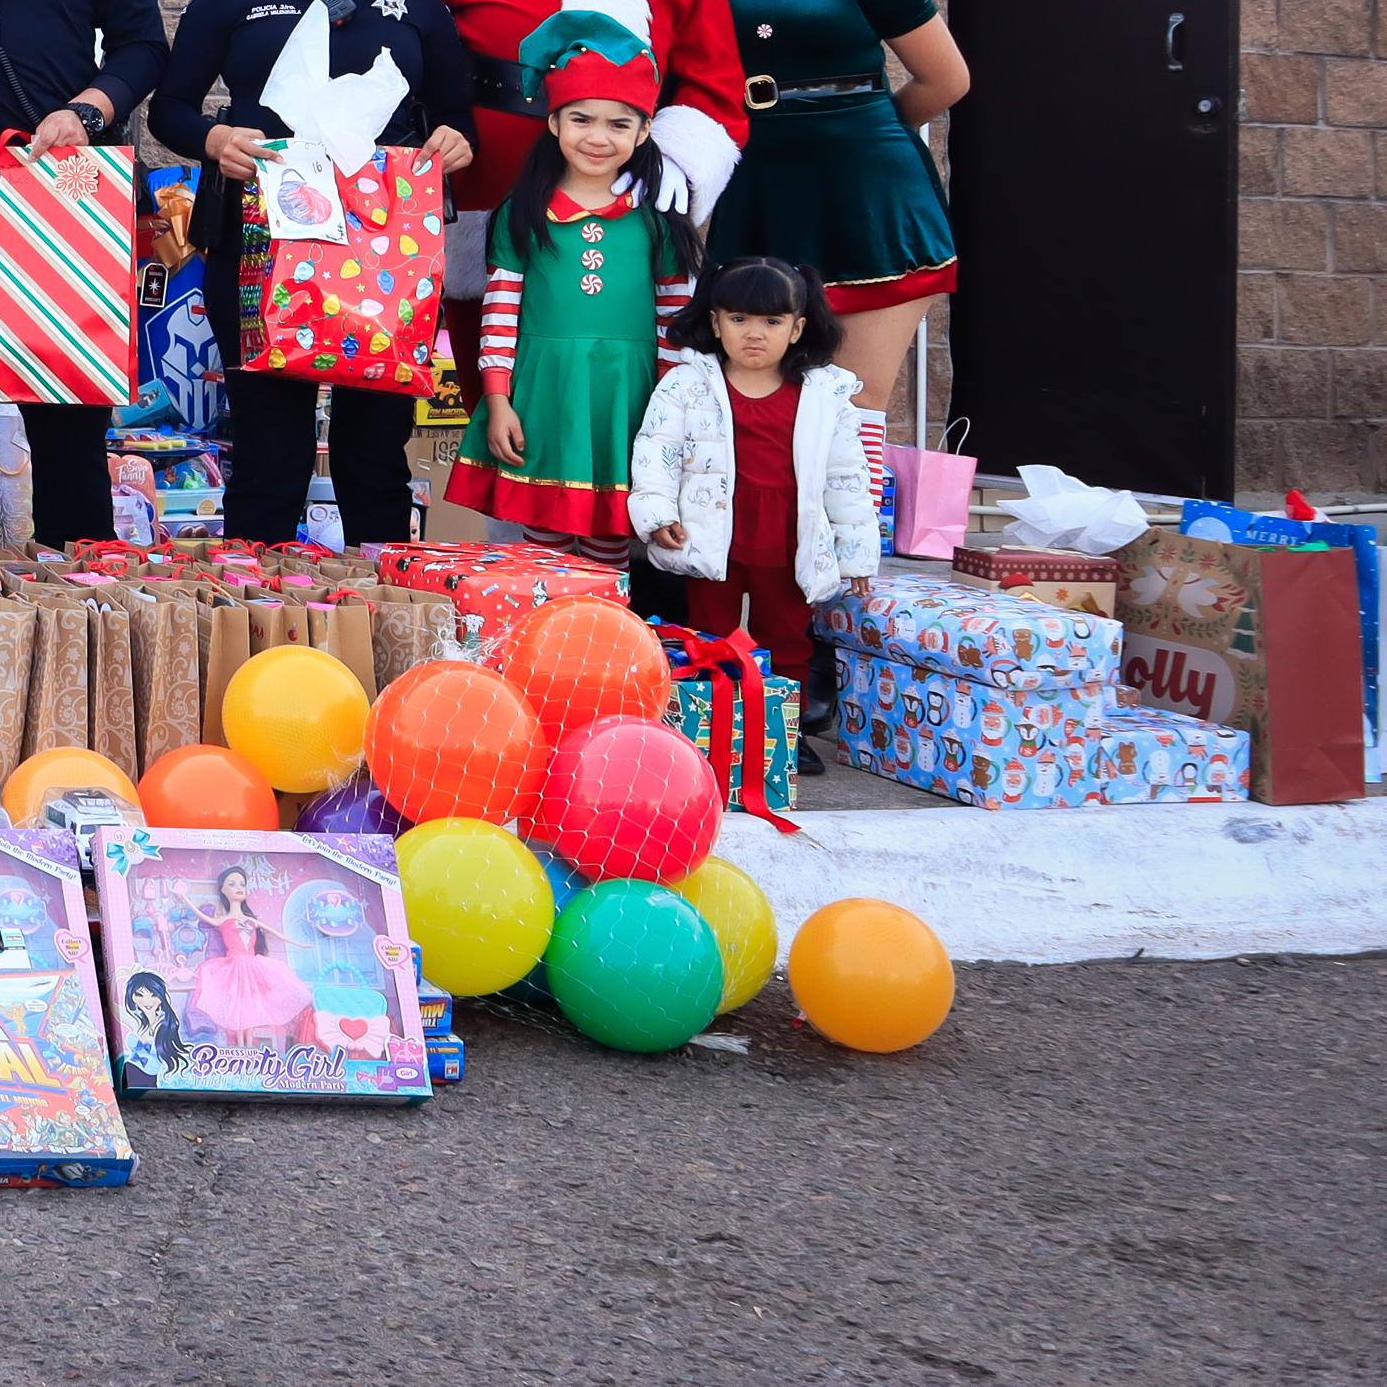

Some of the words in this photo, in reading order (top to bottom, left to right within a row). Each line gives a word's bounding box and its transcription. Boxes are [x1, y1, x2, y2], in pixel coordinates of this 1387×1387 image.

[312, 162, 323, 174] 16
[1245, 529, 1299, 546] MERRY
[1127, 649, 1217, 719] olly
[218, 1047, 244, 1056] DRESS
[247, 1048, 258, 1056] UP
[192, 1044, 283, 1089] Beauty
[279, 1043, 347, 1079] Girl
[279, 1080, 317, 1090] Modern
[319, 1081, 346, 1091] Party
[0, 1094, 10, 1103] EL
